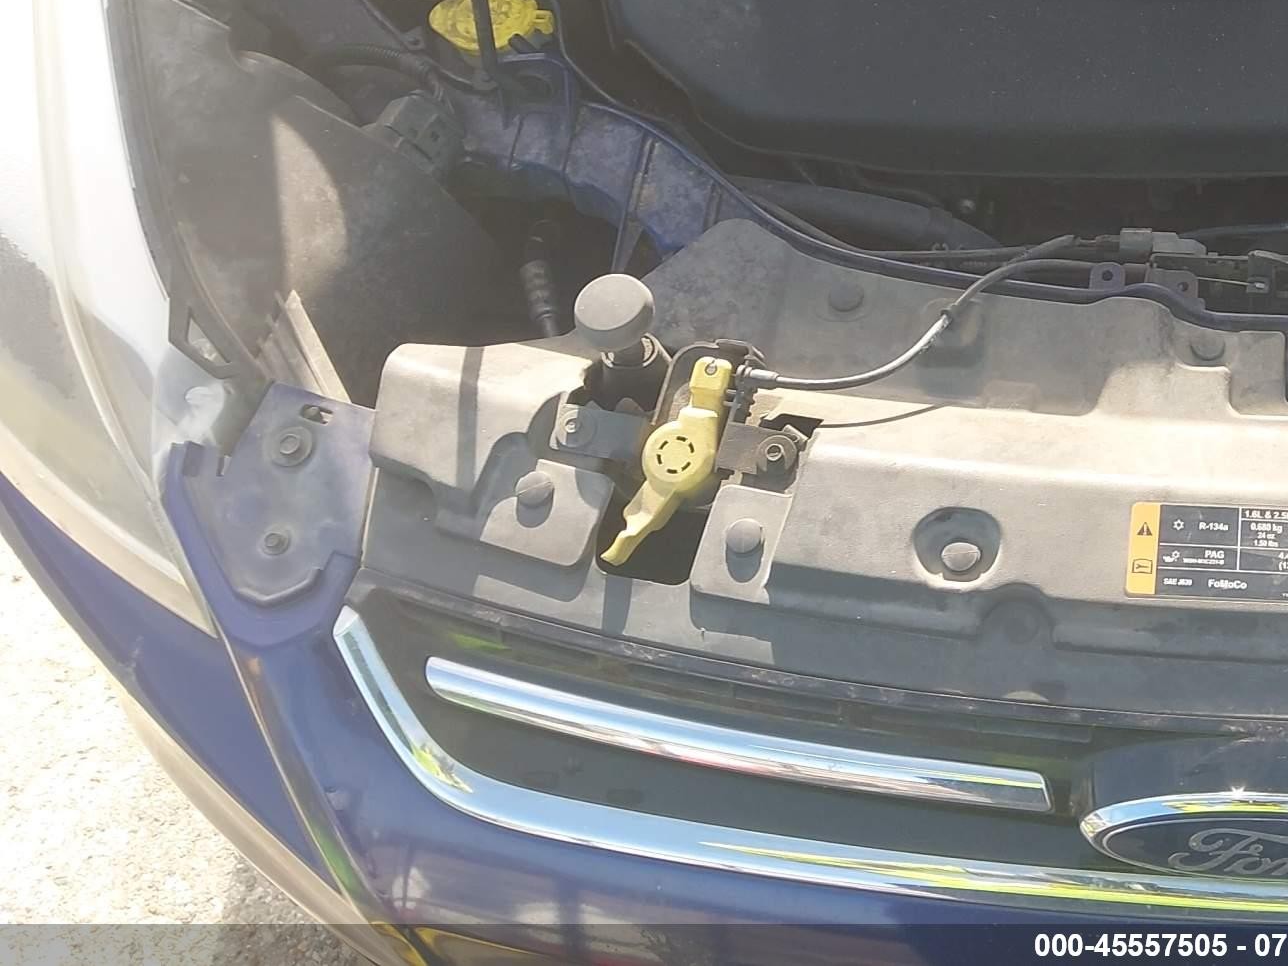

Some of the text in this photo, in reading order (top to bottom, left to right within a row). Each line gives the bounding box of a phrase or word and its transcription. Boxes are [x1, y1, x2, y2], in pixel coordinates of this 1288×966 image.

[1199, 522, 1229, 531] R-134a
[1272, 524, 1283, 533] kg
[1204, 550, 1225, 559] PAG
[1208, 579, 1247, 589] FoMoCo
